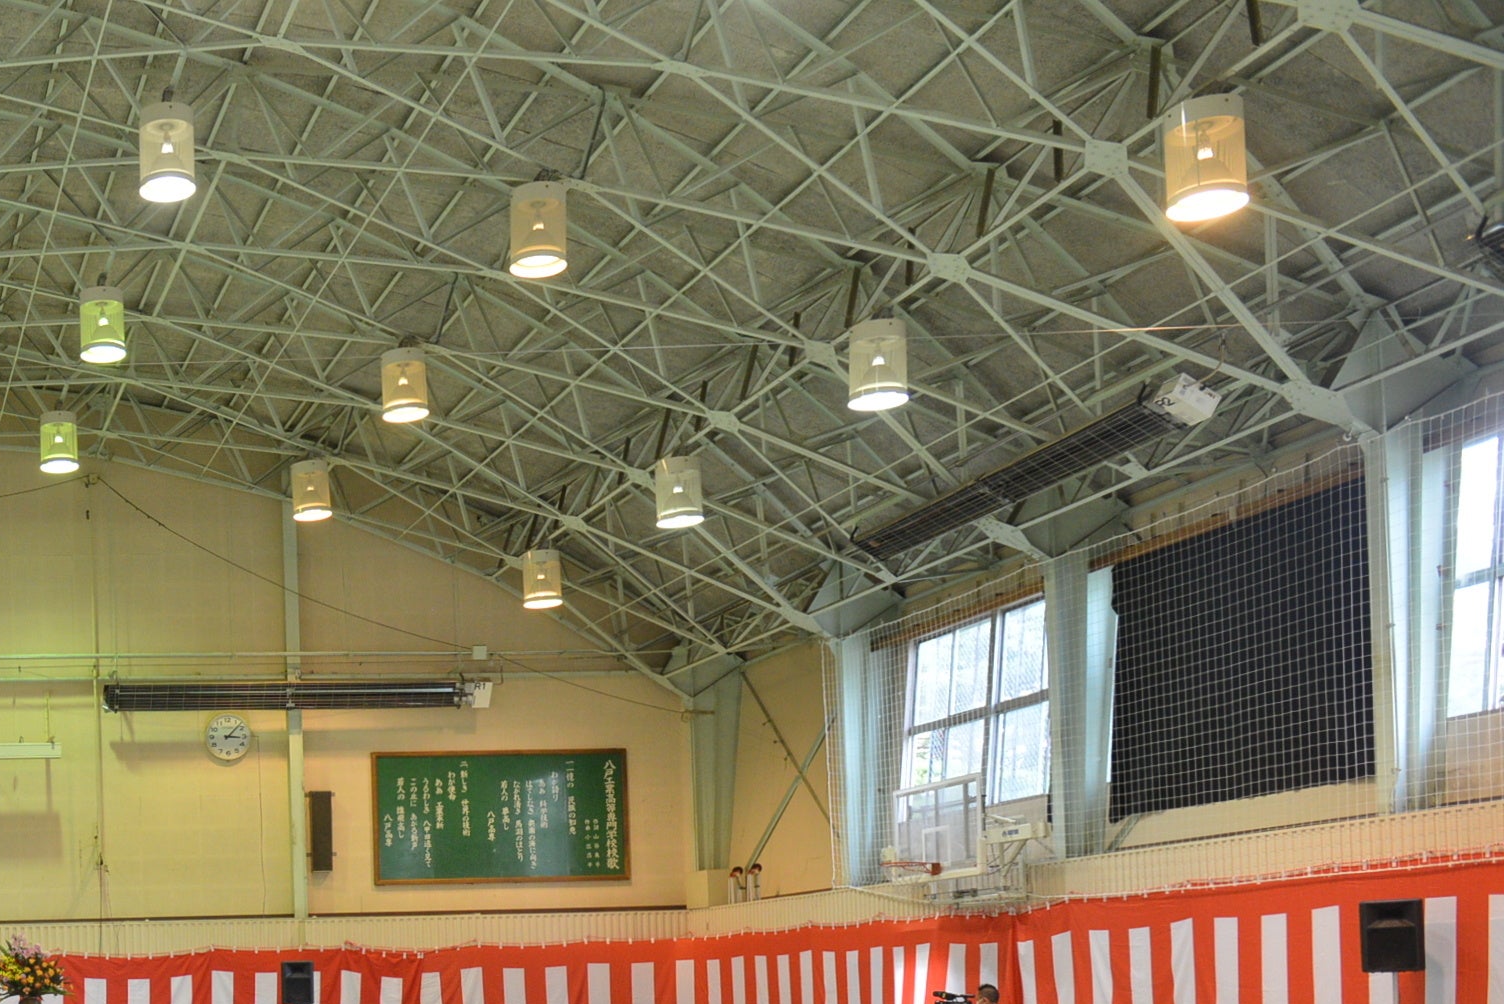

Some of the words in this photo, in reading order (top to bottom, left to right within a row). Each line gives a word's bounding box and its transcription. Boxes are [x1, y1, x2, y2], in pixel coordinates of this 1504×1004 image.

[383, 813, 393, 847] 八戸高専
[486, 810, 496, 842] 八戸高専
[603, 759, 620, 869] 八戸工業高等専門学校校歌
